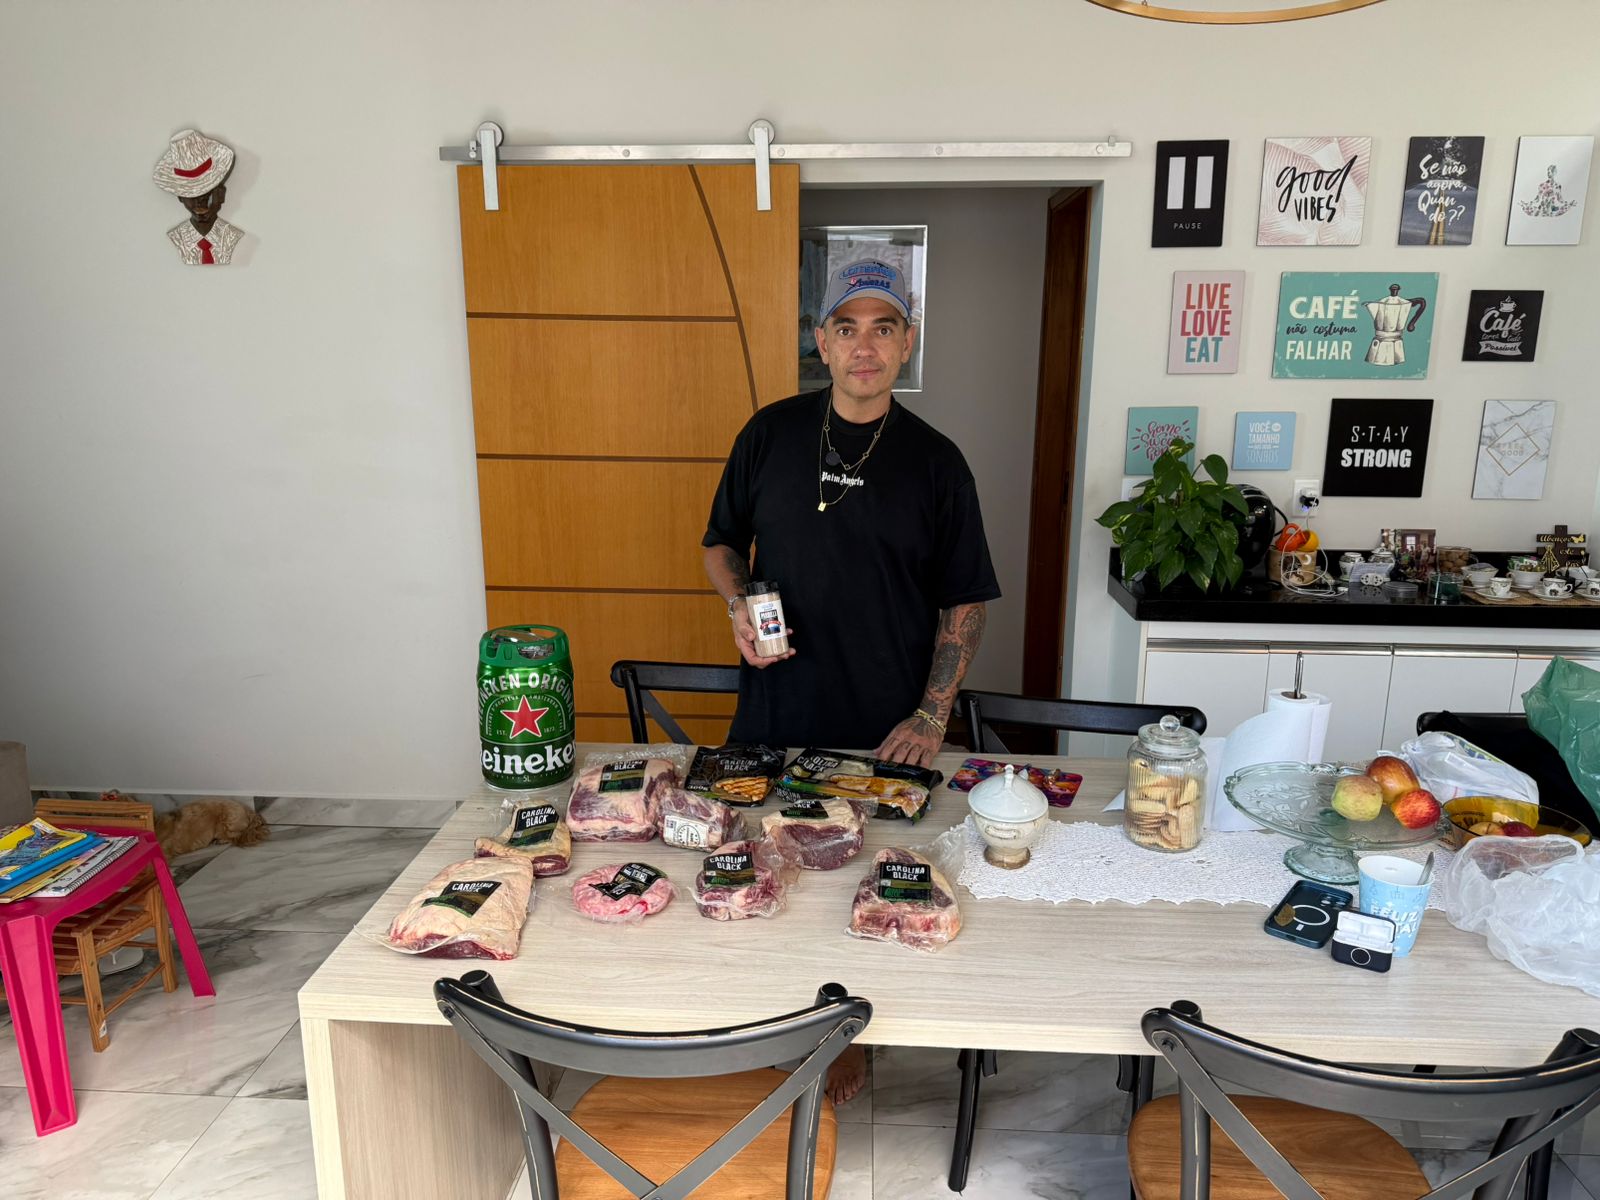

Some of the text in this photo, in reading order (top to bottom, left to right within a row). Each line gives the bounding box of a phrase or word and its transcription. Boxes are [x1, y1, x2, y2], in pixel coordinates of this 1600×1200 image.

[1419, 154, 1467, 179] Se não
[1276, 155, 1358, 213] good
[1294, 195, 1337, 223] VIBES
[1173, 222, 1202, 230] PAUSE
[1185, 283, 1232, 310] LIVE
[1288, 290, 1360, 320] CAFÉ
[1180, 310, 1232, 337] LOVE
[1286, 322, 1358, 335] não costuma
[1480, 309, 1526, 338] Café
[1185, 336, 1223, 363] EAT
[1285, 340, 1352, 361] FALHAR
[1341, 448, 1412, 468] STRONG
[478, 739, 577, 775] eineke
[521, 808, 555, 820] CAROLINA
[526, 815, 548, 828] BLACK
[710, 856, 747, 864] CAROLINA
[717, 862, 742, 870] BLACK
[886, 865, 925, 874] CAROLINA
[893, 872, 919, 880] BLACK
[1370, 904, 1419, 922] FELIZ
